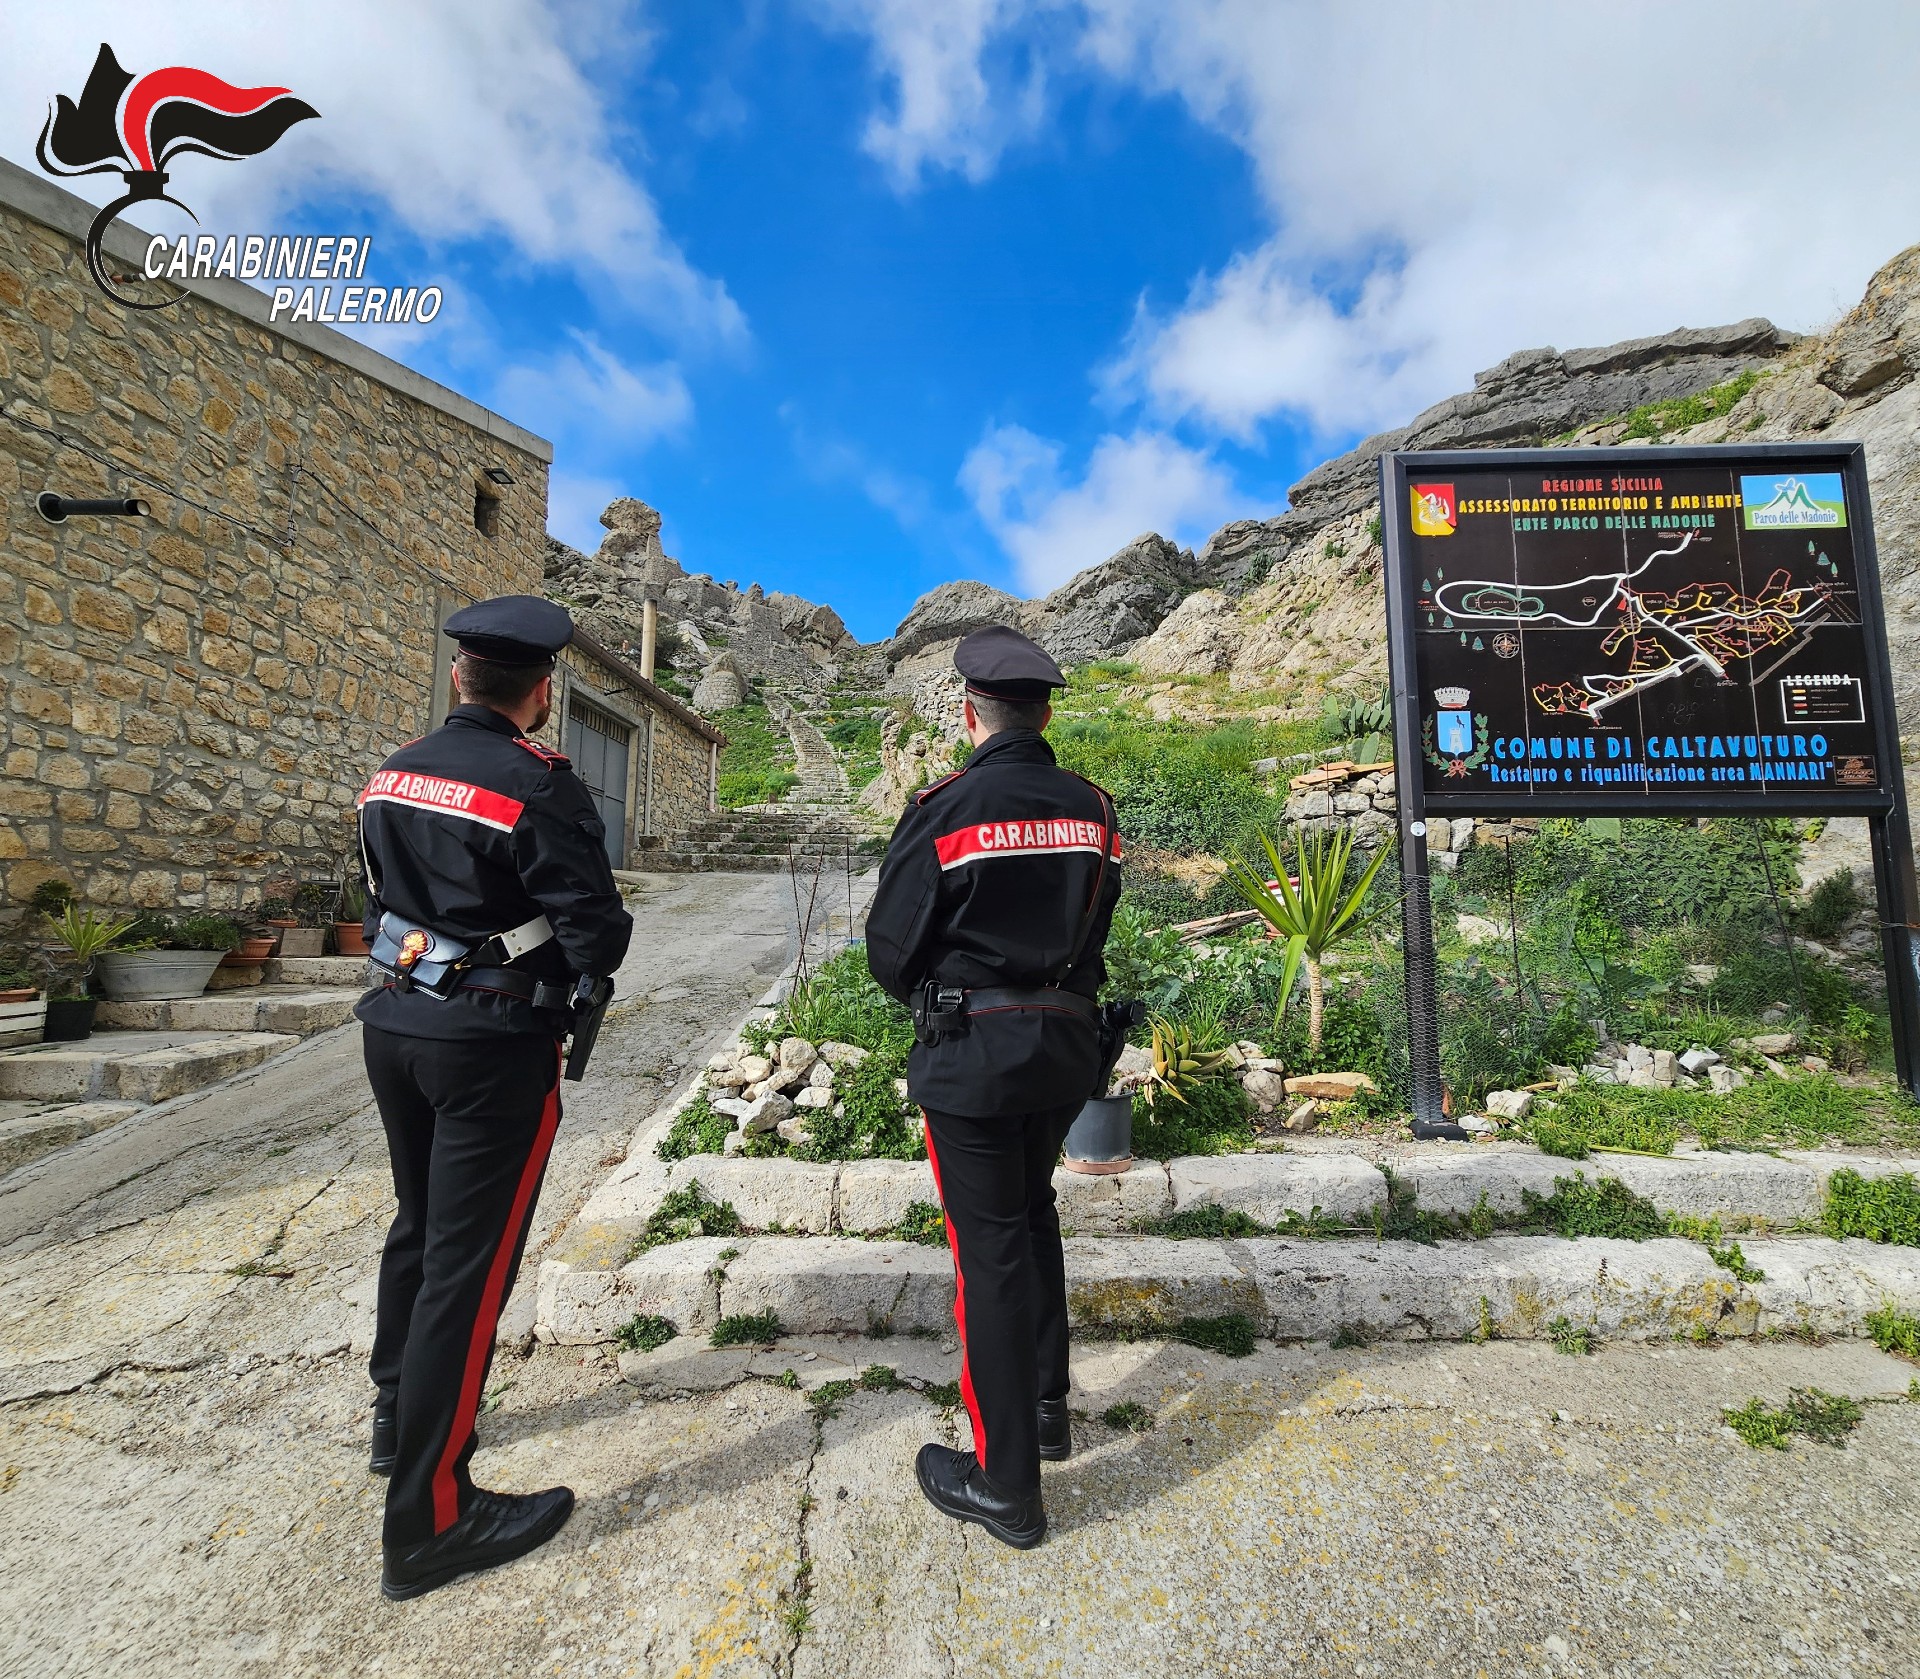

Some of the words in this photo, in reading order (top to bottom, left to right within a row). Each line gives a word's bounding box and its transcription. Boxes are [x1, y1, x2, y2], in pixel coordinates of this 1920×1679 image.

[1542, 479, 1603, 492] REGIONE
[1611, 478, 1663, 491] SICILIA
[1459, 498, 1557, 513] ASSESSORATO
[1561, 496, 1648, 511] TERRITORIO
[1655, 496, 1663, 510] E
[1671, 494, 1742, 509] AMBIENTE
[1514, 517, 1548, 531] ENTE
[1554, 516, 1598, 530] PARCO
[1605, 516, 1646, 529] DELLE
[1651, 514, 1716, 528] MADONIE
[1754, 512, 1778, 524] Parco
[1779, 511, 1799, 523] delle
[1801, 509, 1836, 523] Madonie
[1786, 674, 1852, 686] LEGENDA
[1494, 737, 1596, 759] COMUNE
[1607, 736, 1632, 758] DI
[1647, 734, 1828, 758] CALTAVUTURO
[1564, 768, 1573, 782] e
[1581, 763, 1705, 785] riqualificazione
[1711, 767, 1745, 781] area
[369, 772, 477, 809] CARABINIERI
[978, 821, 1101, 850] CARABINIERI
